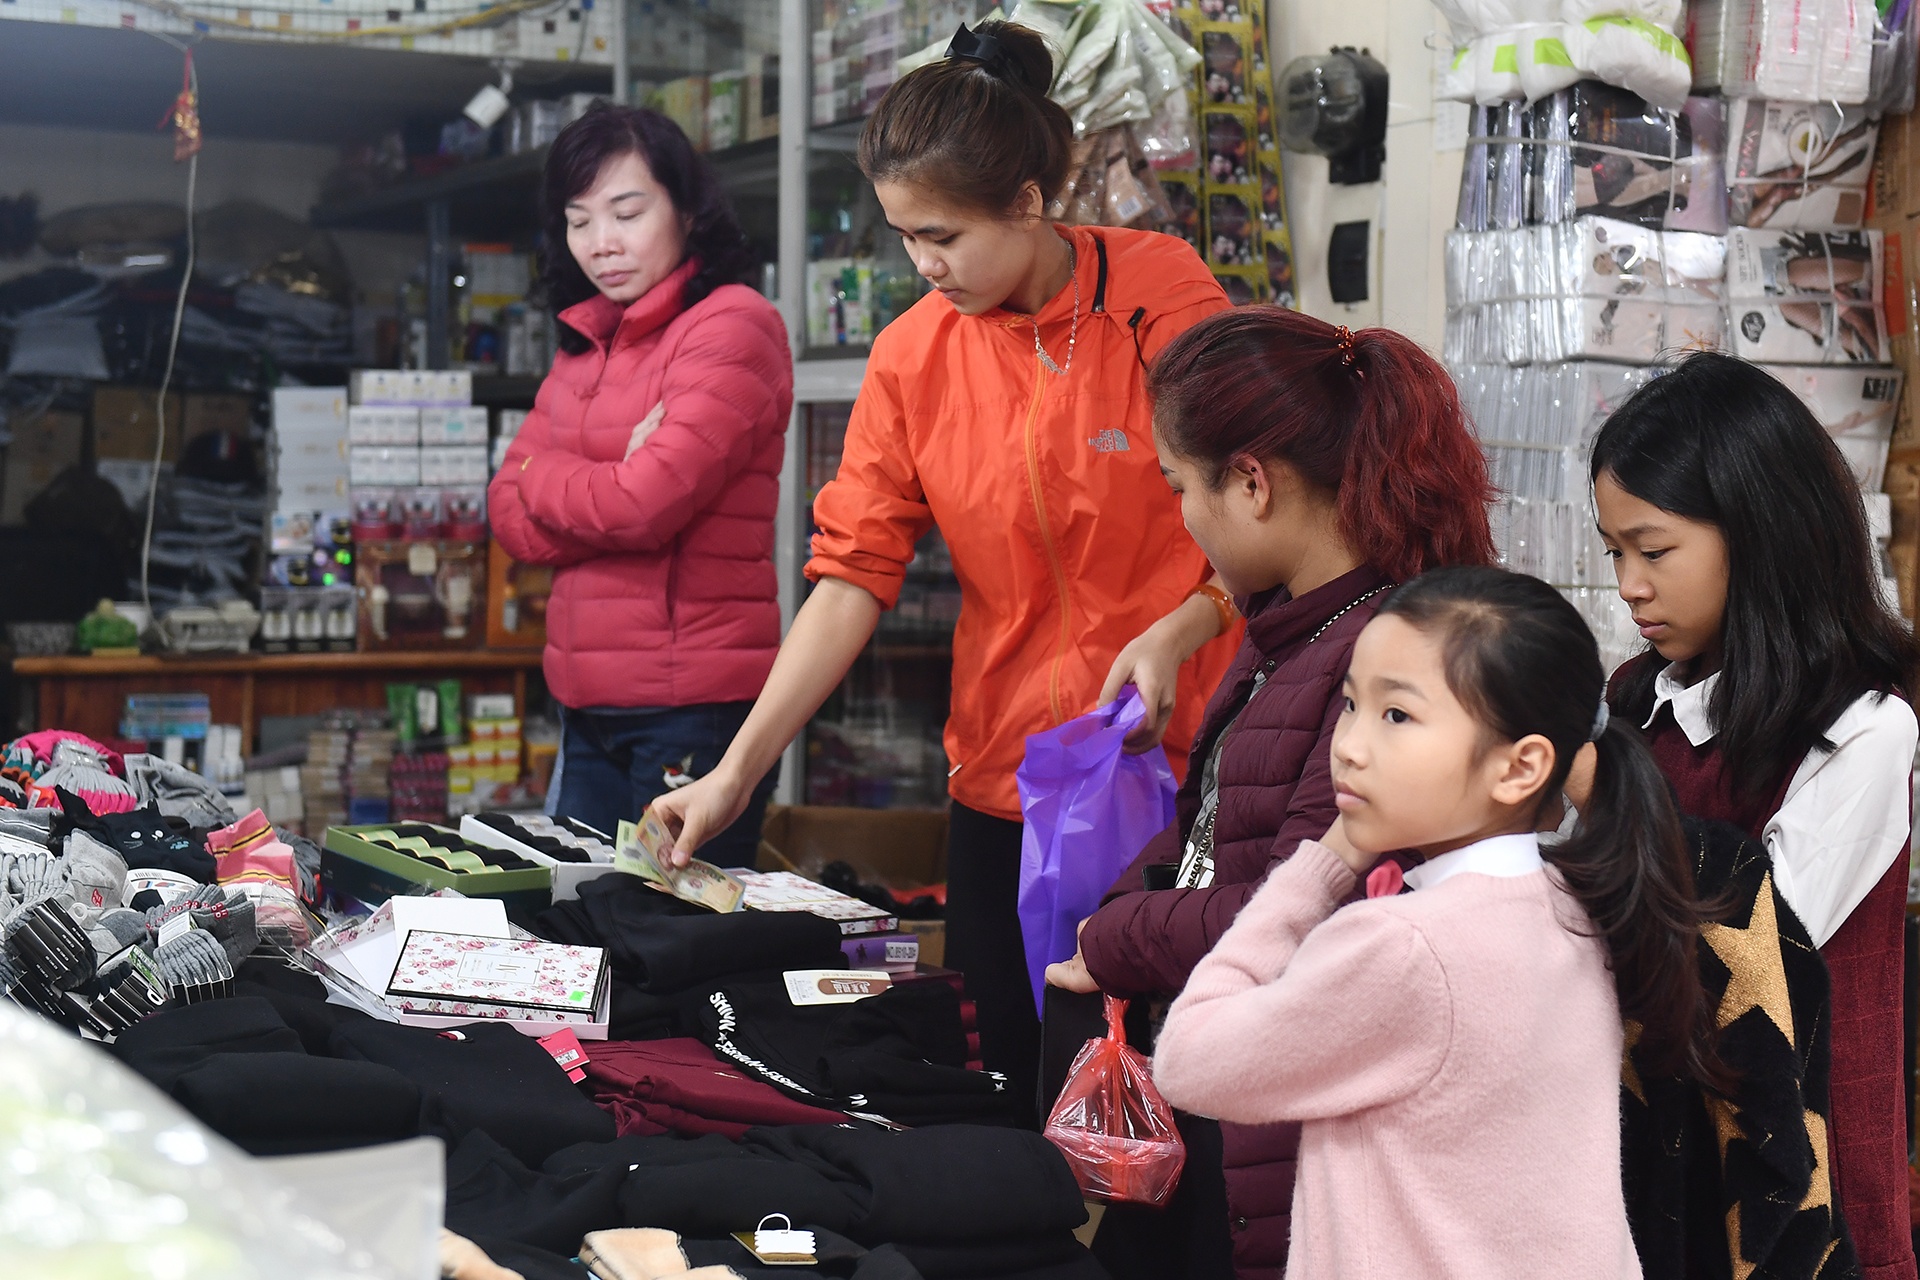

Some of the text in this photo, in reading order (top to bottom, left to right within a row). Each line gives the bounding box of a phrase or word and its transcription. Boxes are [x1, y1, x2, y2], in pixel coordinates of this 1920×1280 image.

[1099, 429, 1112, 437] THE
[1088, 437, 1114, 446] NORTH
[1096, 445, 1114, 453] FACE
